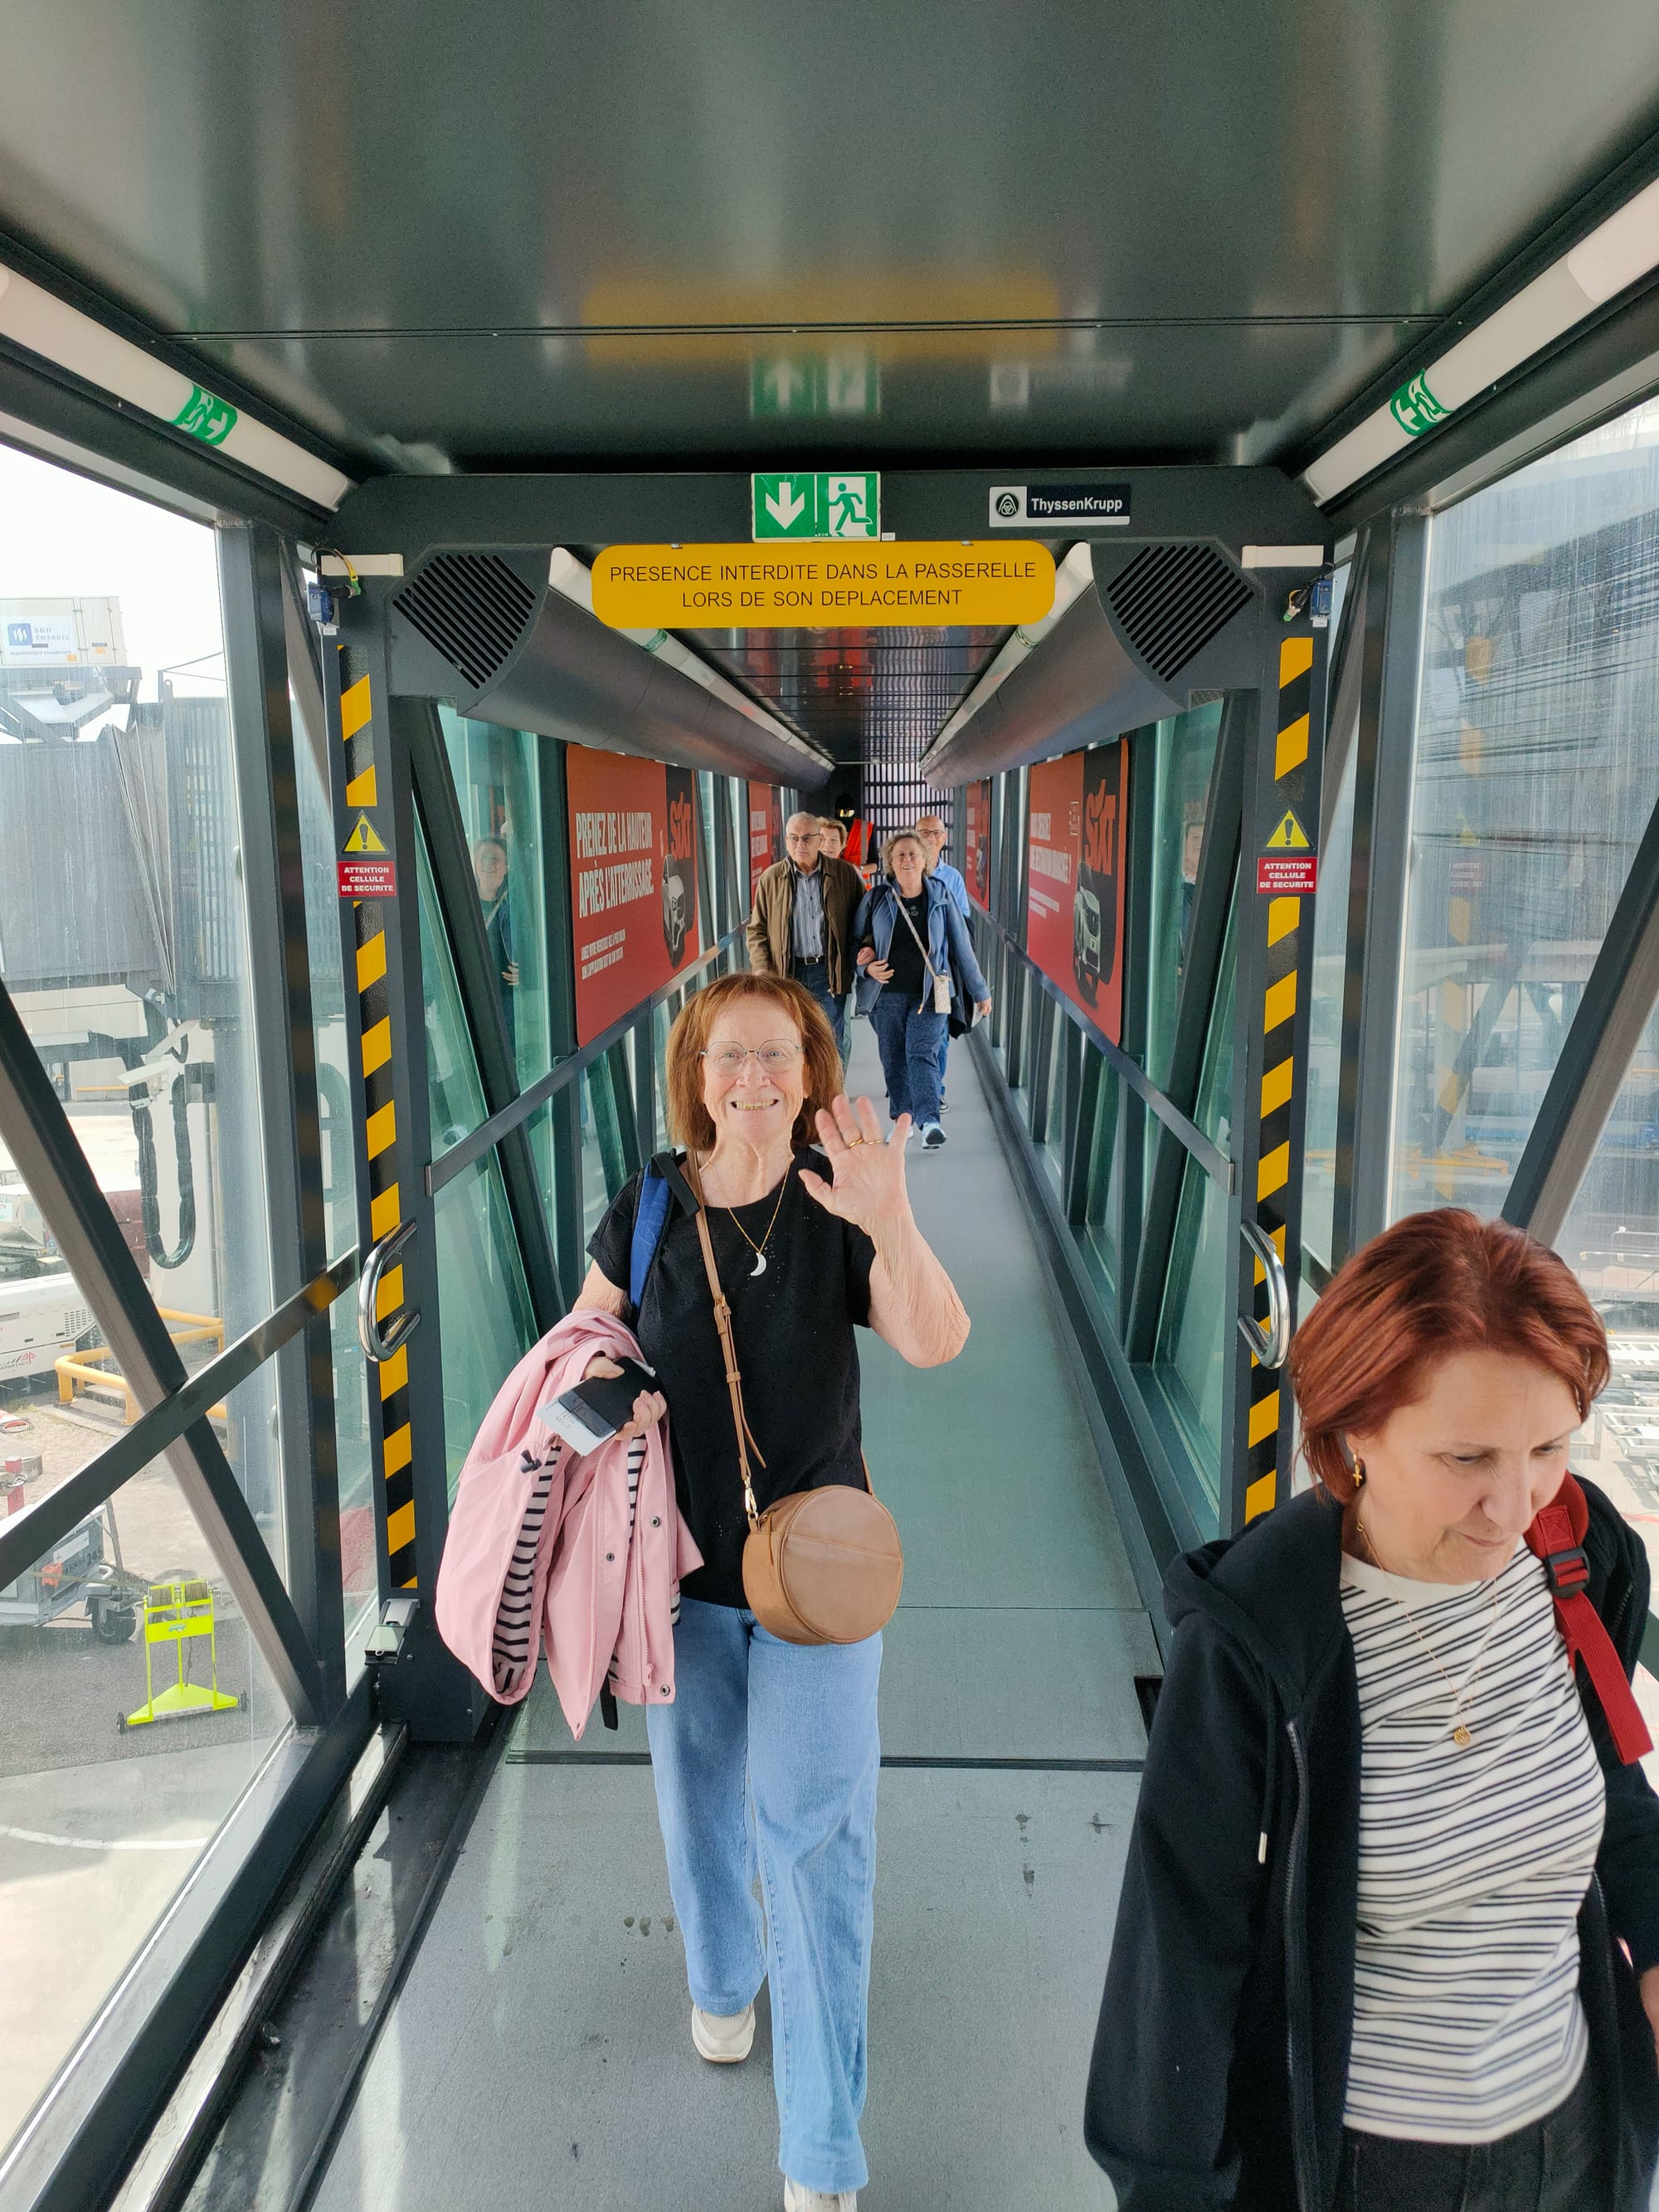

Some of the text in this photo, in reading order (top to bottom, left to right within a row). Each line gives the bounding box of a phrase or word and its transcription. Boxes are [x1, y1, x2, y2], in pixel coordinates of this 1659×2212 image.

[1031, 498, 1122, 513] ThyssenKrupp
[611, 562, 1036, 581] PRESENCE INTERDITE DANS LA PASSERELLE
[683, 590, 962, 607] LORS DE SON DEPLACEMENT
[576, 812, 606, 859] PRENEZ
[607, 812, 617, 854] DE
[617, 812, 626, 853] LA
[627, 812, 652, 851] HAUTEUR
[579, 859, 605, 919] APRÈS
